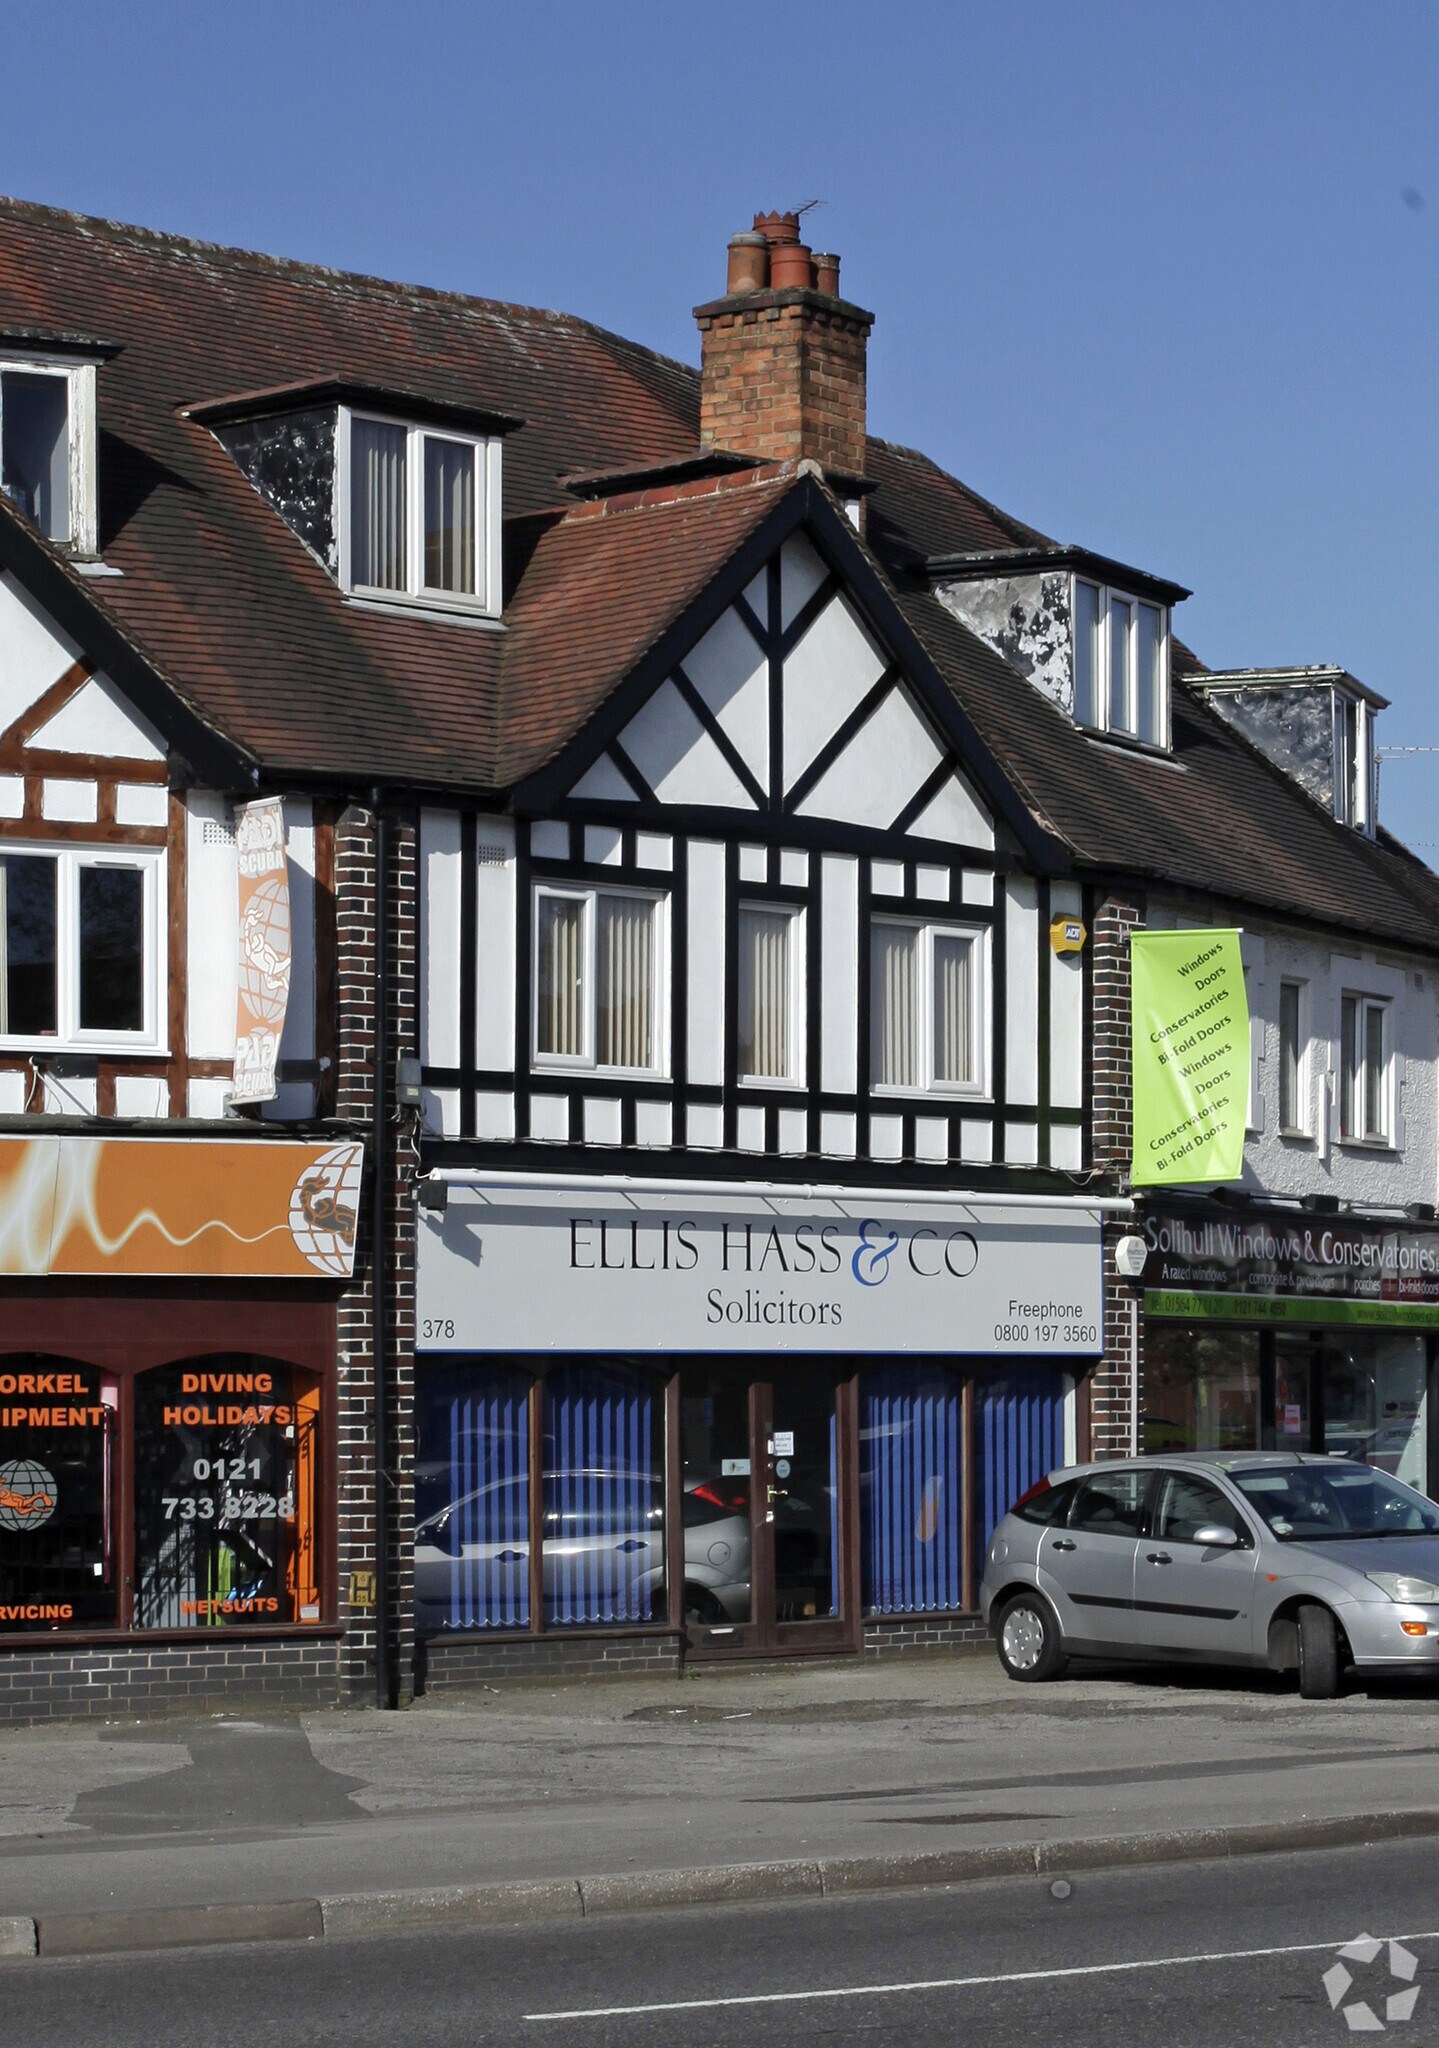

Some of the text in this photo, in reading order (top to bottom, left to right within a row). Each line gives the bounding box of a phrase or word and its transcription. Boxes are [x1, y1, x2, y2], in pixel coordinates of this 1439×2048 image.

[239, 850, 285, 873] SCUBA
[1065, 927, 1080, 939] ADT
[1177, 943, 1223, 977] Windows
[1194, 966, 1226, 991] Doors
[1150, 989, 1229, 1043] Conservatories
[1196, 1015, 1232, 1041] Doors
[1178, 1042, 1232, 1078] Windows
[1195, 1069, 1231, 1094] Doors
[1149, 1096, 1230, 1150] Conservatories
[1193, 1121, 1228, 1147] Doors
[569, 1218, 979, 1287] ELLIS HASS & CO
[1145, 1216, 1436, 1273] Solihull Windows & Conservatories
[1191, 1266, 1228, 1283] windows
[1354, 1276, 1381, 1294] porches
[707, 1288, 842, 1326] Solicitors
[1008, 1300, 1083, 1320] Freephone
[423, 1319, 455, 1339] 378
[994, 1324, 1097, 1343] 0800 197 3560
[0, 1374, 89, 1394] ORKEL
[182, 1373, 273, 1393] DIVING
[3, 1407, 105, 1427] IPMENT
[163, 1405, 291, 1426] HOLIDAYS
[193, 1458, 261, 1480] 0121
[162, 1496, 295, 1519] 733 8228
[179, 1596, 279, 1615] WETSUITS
